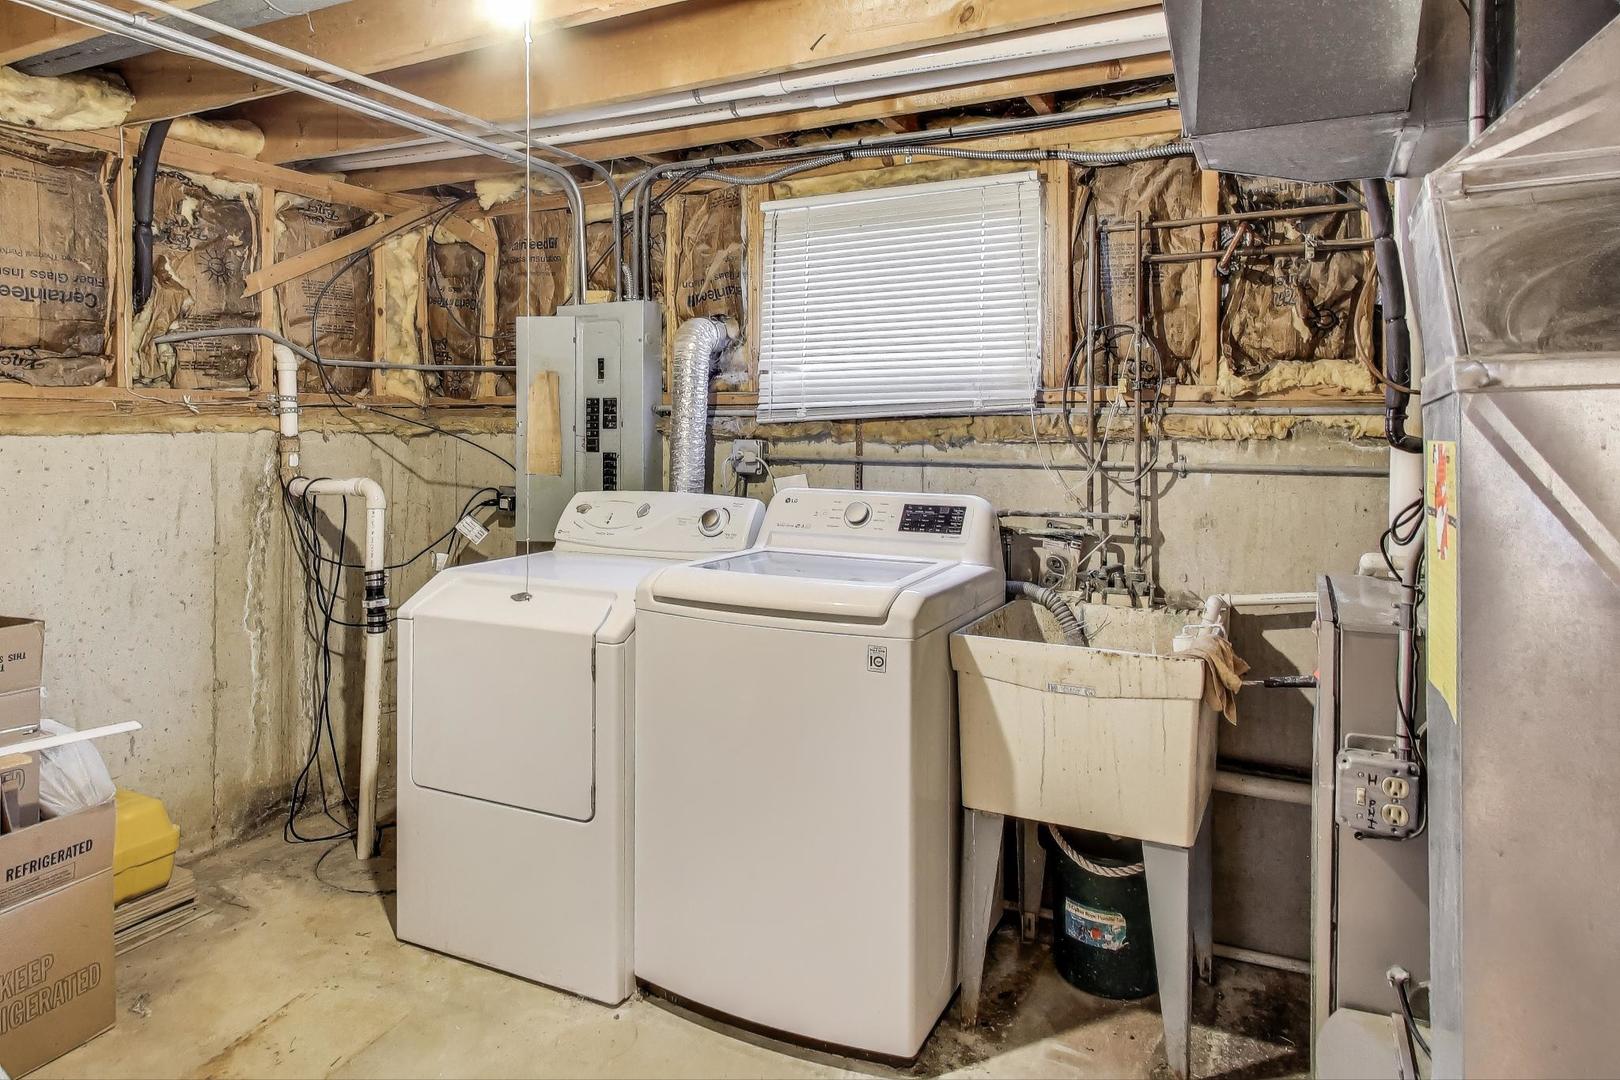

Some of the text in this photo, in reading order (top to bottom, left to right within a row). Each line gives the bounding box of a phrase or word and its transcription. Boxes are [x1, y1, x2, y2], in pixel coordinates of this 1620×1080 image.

[0, 266, 105, 288] Fiber Glass Ins
[8, 652, 26, 662] THIS
[6, 839, 94, 882] REFRIGERATED
[0, 954, 55, 1002] KEEP
